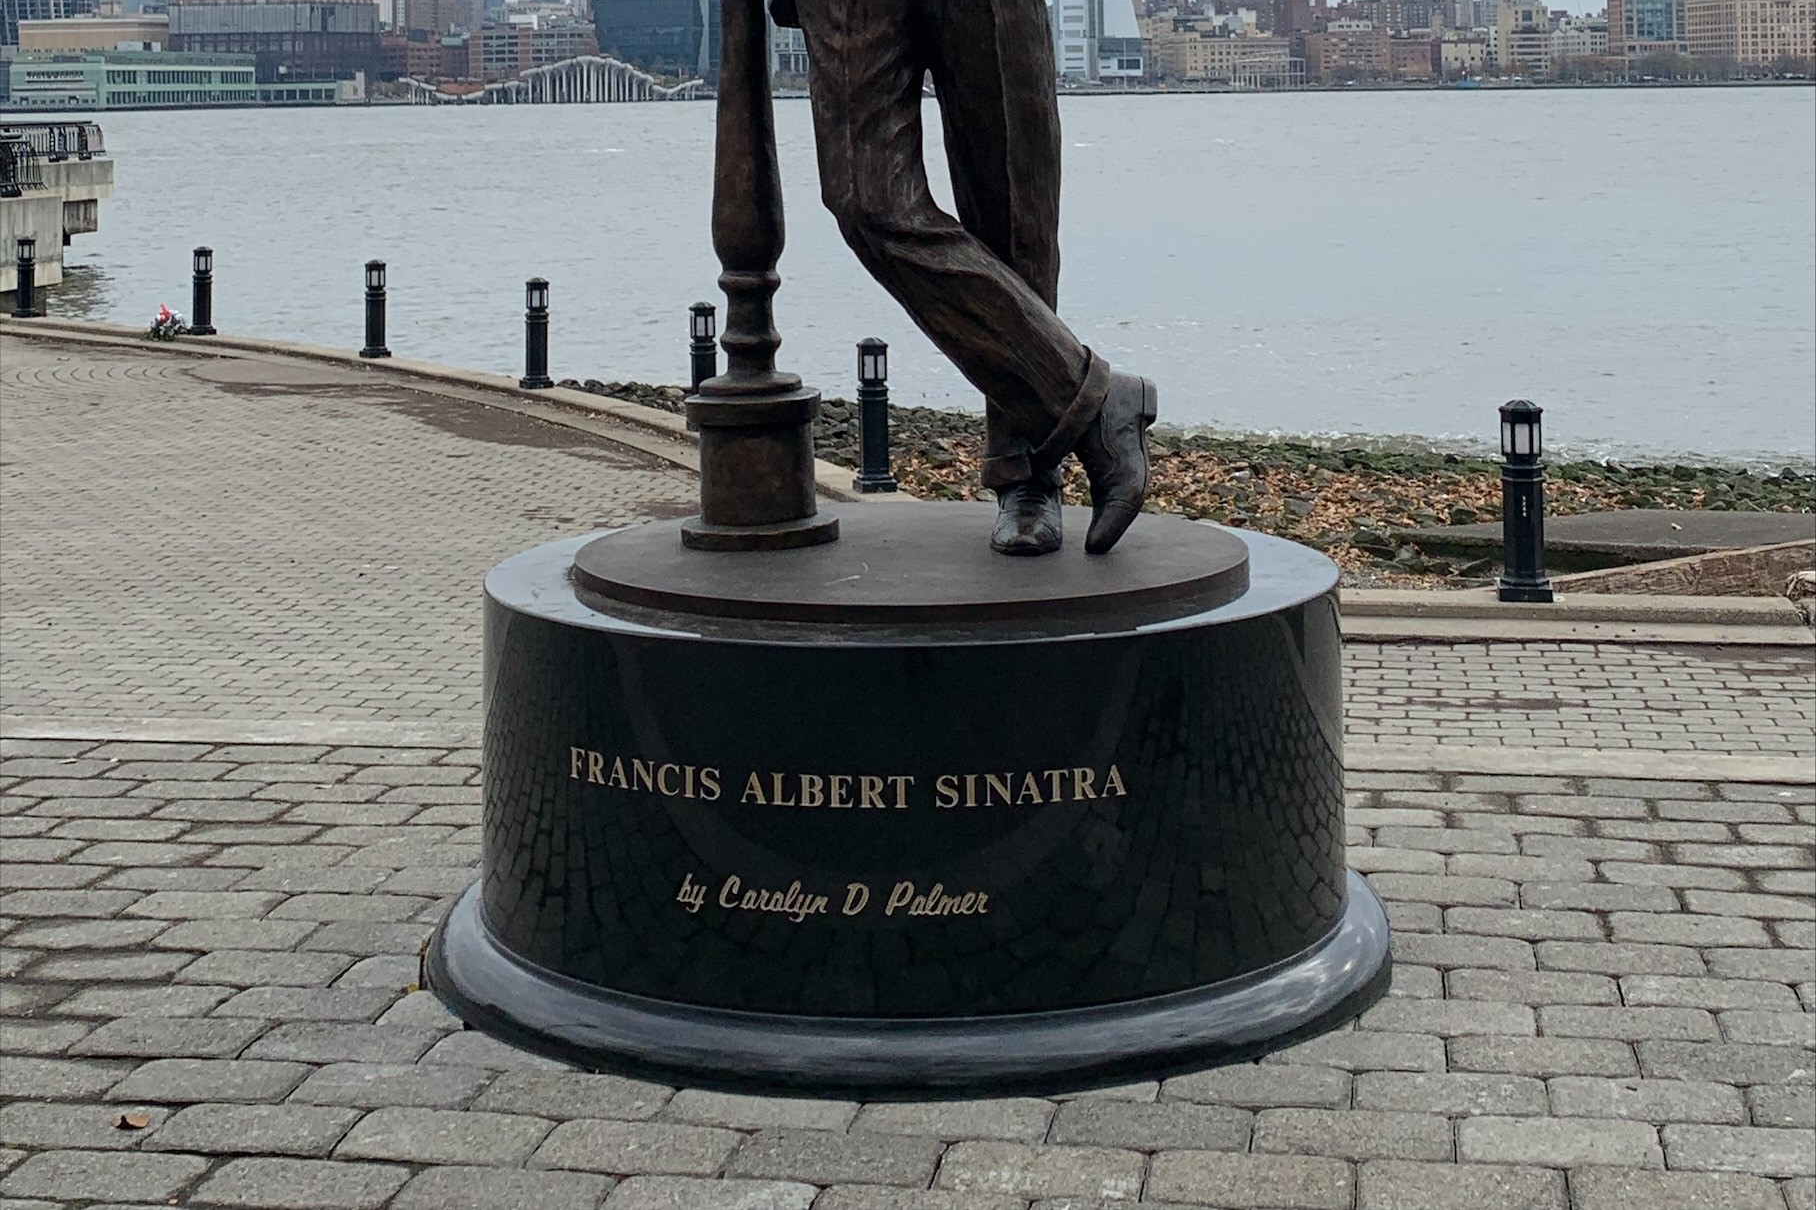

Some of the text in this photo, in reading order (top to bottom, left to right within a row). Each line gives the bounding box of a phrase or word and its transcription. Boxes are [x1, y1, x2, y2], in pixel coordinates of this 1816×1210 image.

[570, 746, 1127, 809] FRANCIS ALBERT SINATRA
[676, 873, 707, 913] by
[842, 882, 870, 916] D
[885, 881, 989, 916] Palmer
